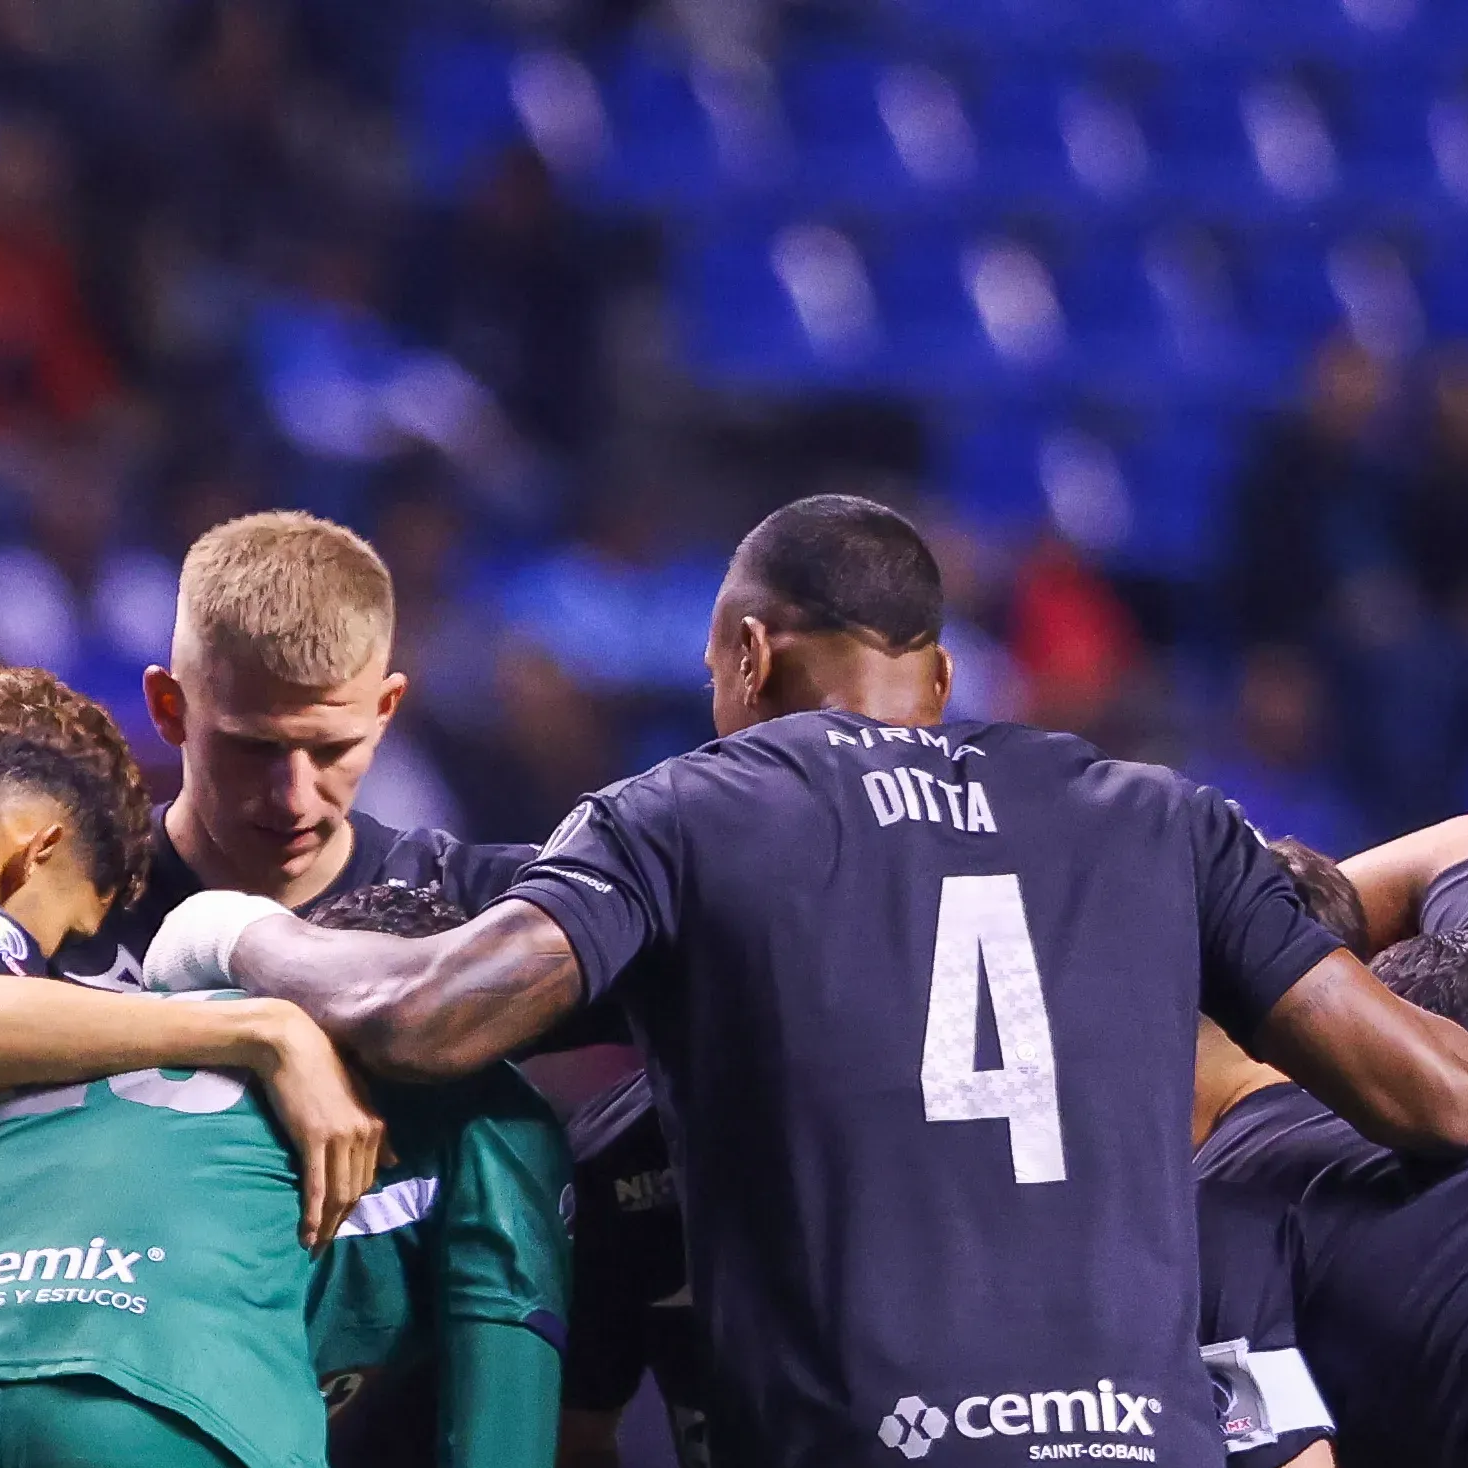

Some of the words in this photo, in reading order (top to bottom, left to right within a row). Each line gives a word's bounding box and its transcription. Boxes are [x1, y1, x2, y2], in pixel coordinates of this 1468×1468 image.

[861, 766, 998, 833] DITTA
[920, 872, 1067, 1185] 4
[13, 1288, 33, 1305] Y
[34, 1287, 149, 1316] ESTUCOS
[1028, 1443, 1156, 1463] SAINT-GOBAIN
